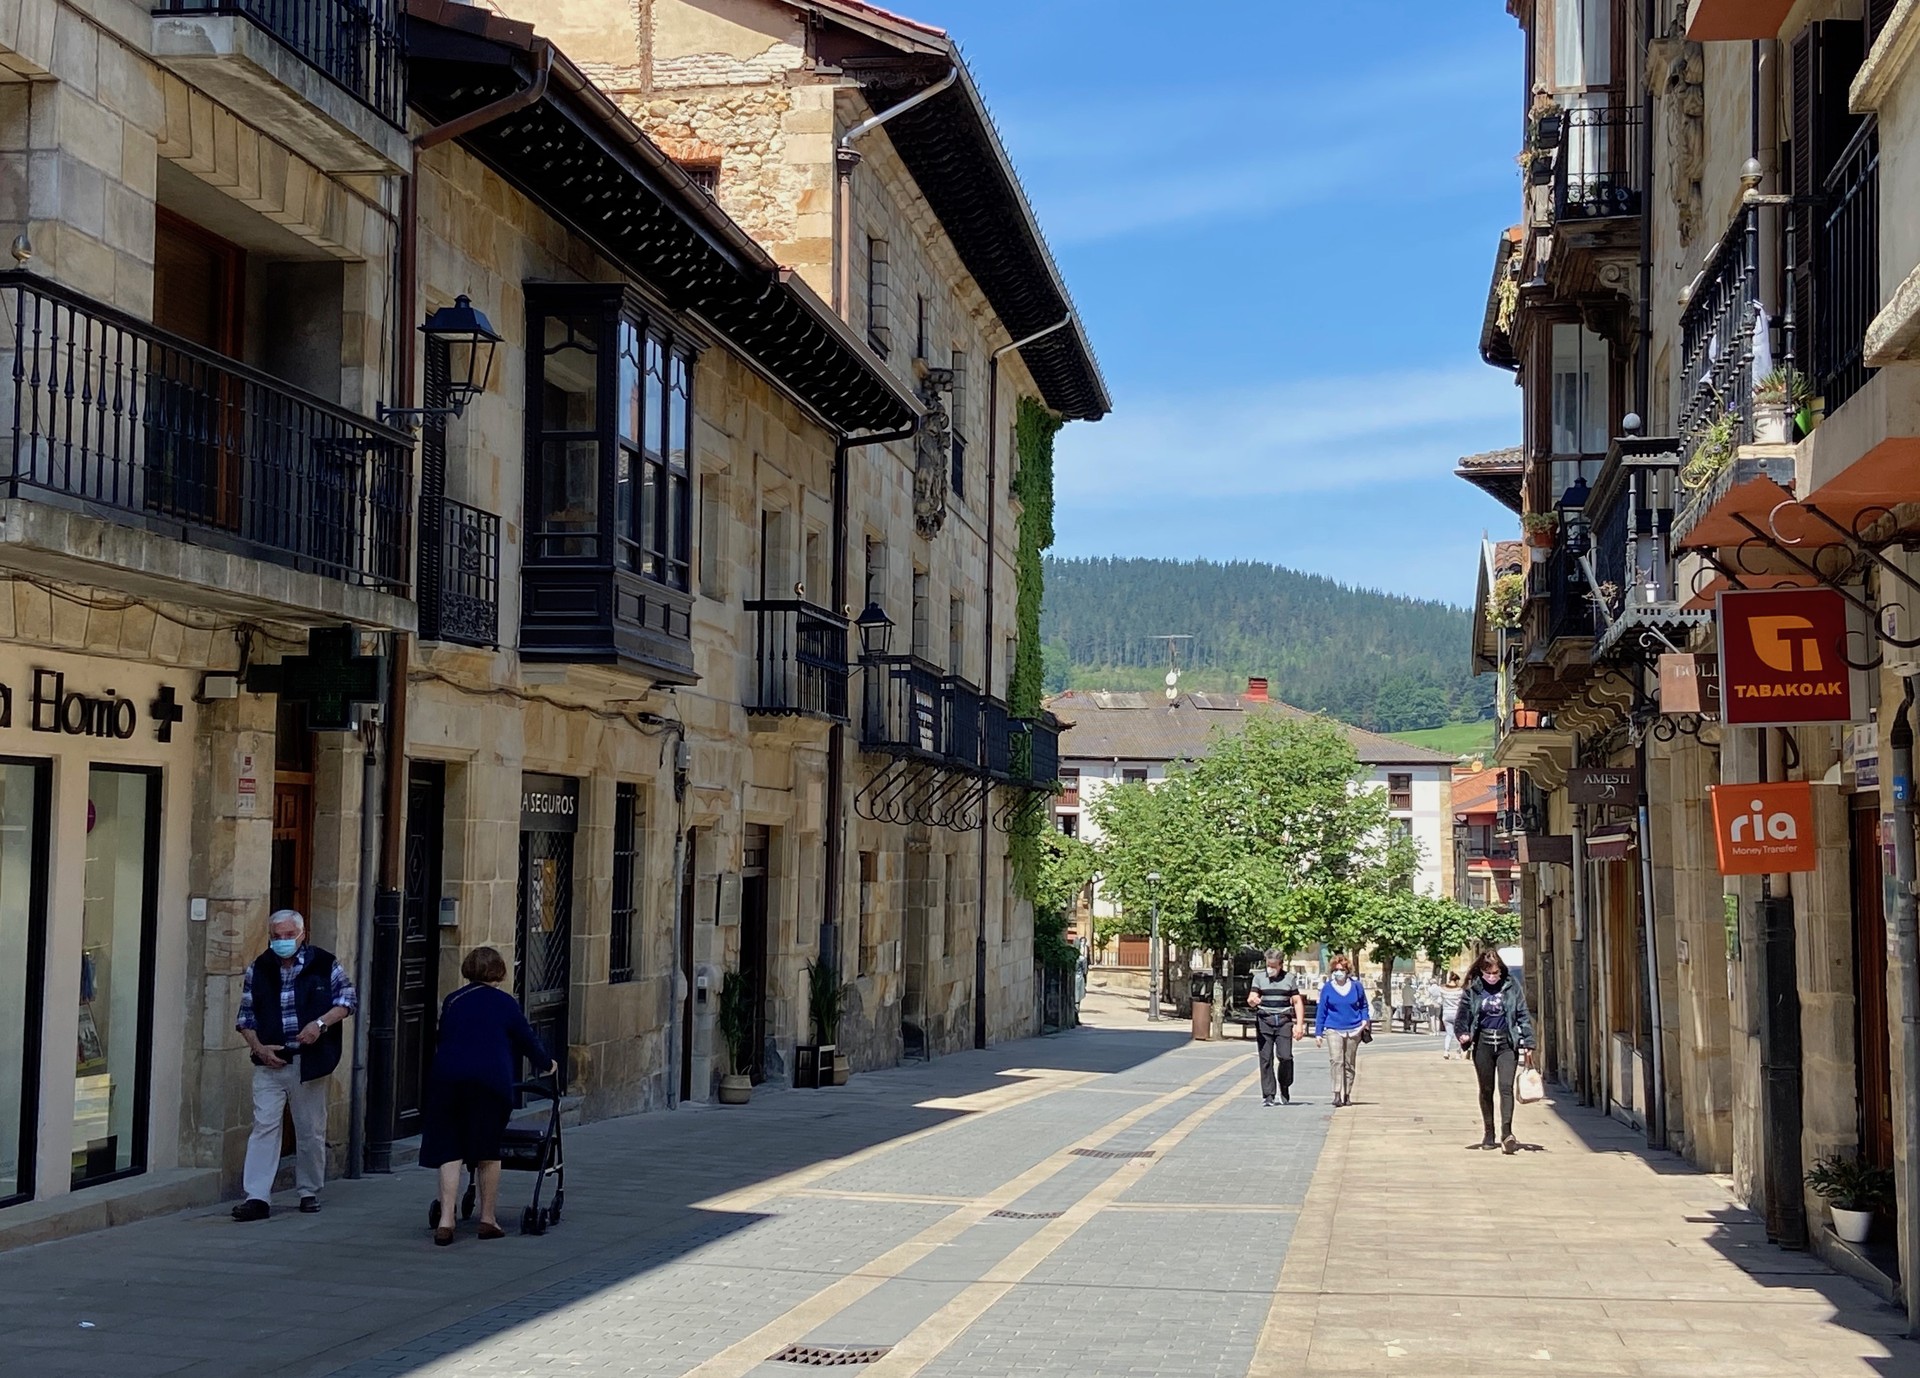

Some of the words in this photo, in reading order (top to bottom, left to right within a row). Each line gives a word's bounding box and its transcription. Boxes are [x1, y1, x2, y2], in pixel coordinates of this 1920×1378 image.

[1734, 681, 1842, 698] TABAKOAK
[1583, 773, 1631, 784] AMESTI
[530, 792, 575, 815] SEGUROS
[1730, 799, 1797, 843] ria
[1732, 847, 1762, 856] Money
[1762, 844, 1798, 854] Transfer
